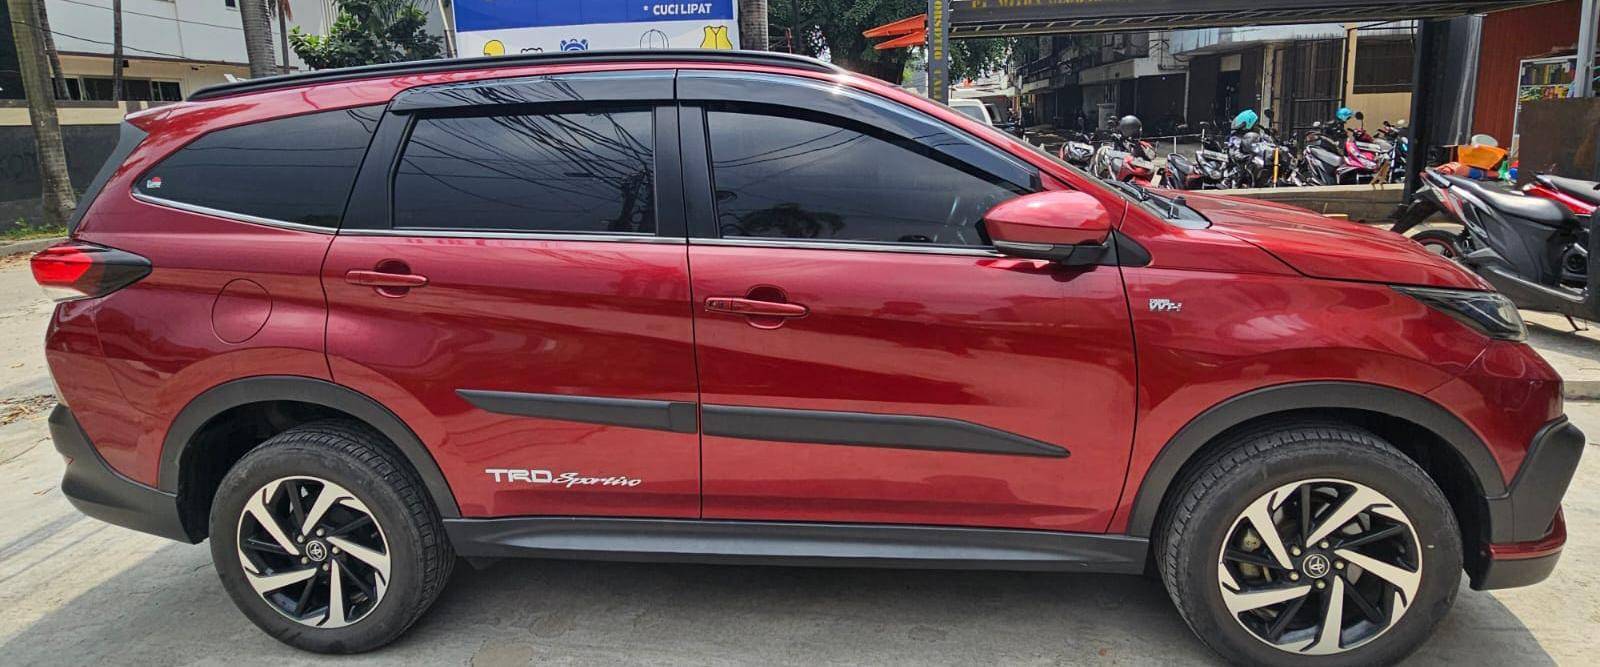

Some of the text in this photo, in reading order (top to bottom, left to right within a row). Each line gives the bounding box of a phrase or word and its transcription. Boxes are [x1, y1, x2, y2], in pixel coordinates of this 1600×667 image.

[653, 3, 712, 15] CUCI LIPAT
[485, 468, 642, 488] TRD Sportivo
